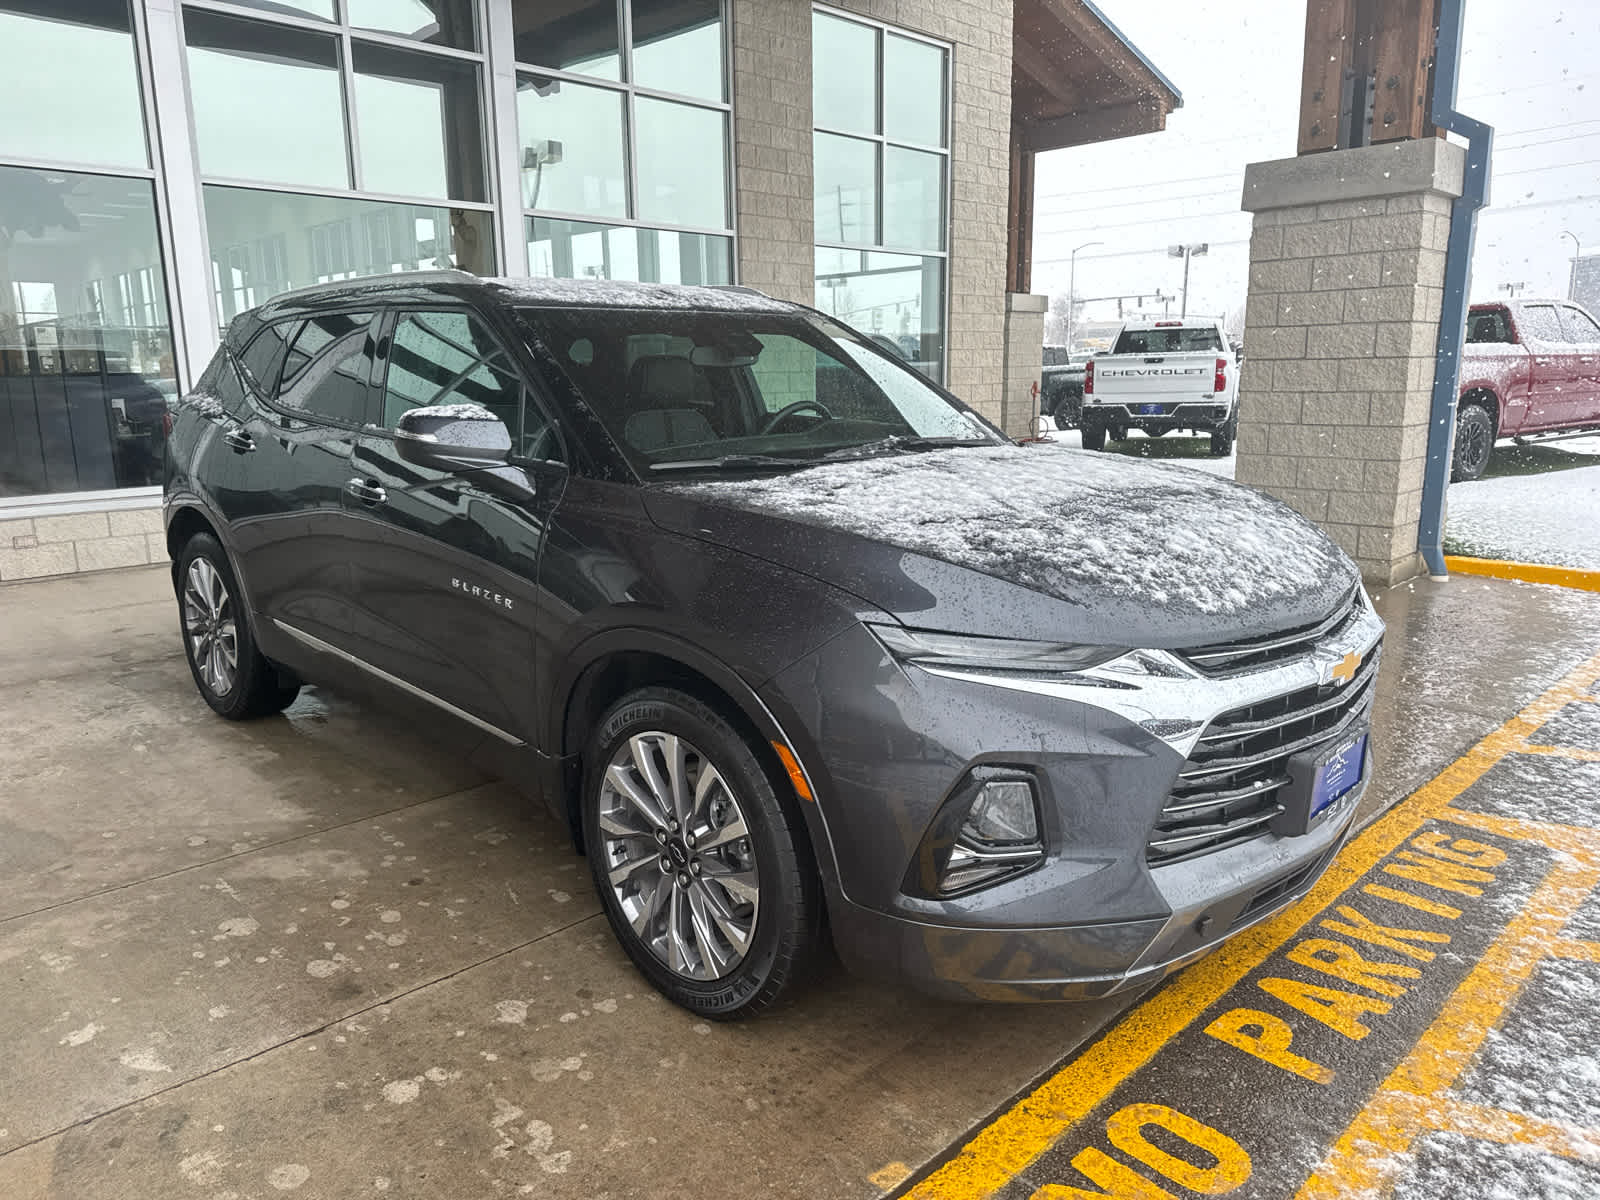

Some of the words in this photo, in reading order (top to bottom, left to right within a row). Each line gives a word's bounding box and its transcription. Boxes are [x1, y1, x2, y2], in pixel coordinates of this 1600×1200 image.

[1101, 367, 1208, 377] CHEVROLET
[451, 577, 513, 610] BLAZER
[609, 705, 664, 736] MICHELIN
[1202, 831, 1508, 1085] PARKING
